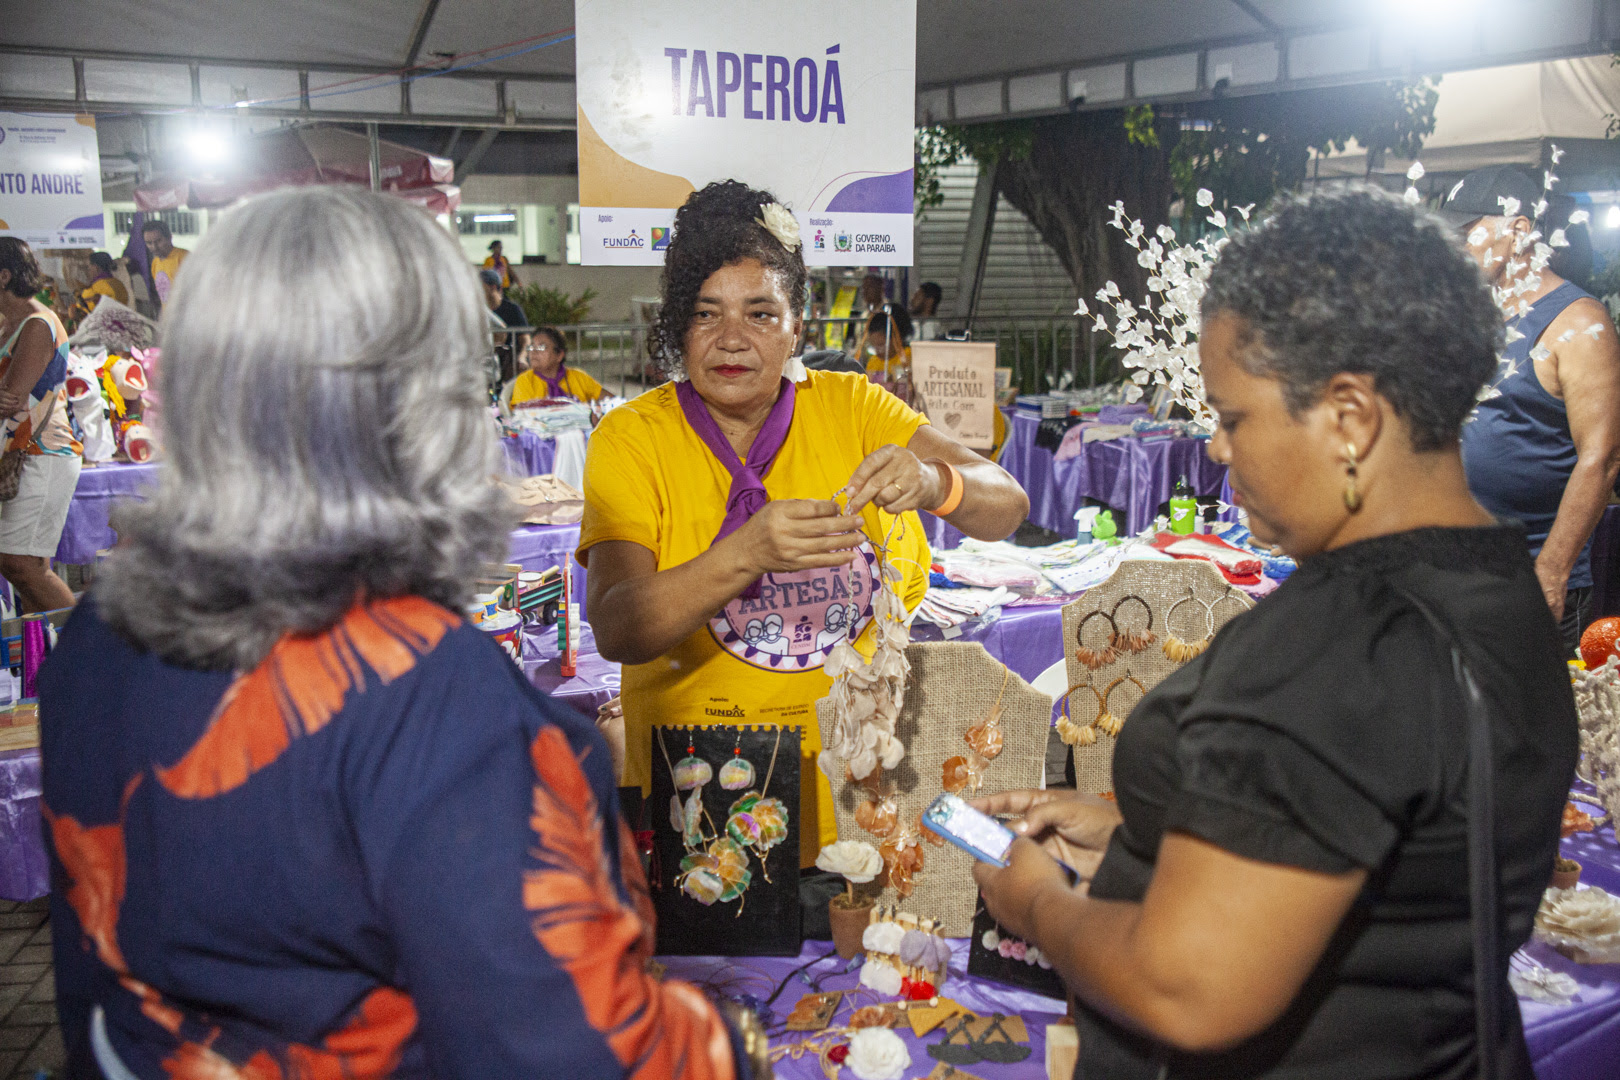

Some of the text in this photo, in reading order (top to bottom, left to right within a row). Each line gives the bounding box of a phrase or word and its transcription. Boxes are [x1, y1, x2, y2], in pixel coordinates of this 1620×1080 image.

[664, 43, 846, 125] TAPEROÁ
[809, 218, 834, 228] Realização:
[603, 237, 645, 248] FUNDAC
[855, 233, 891, 243] GOVERNO
[855, 243, 896, 253] DA PARAÍBA
[929, 366, 977, 380] Produto
[922, 381, 987, 398] ARTESANAL
[738, 567, 863, 615] ARTESÃS
[705, 707, 745, 717] FUNDAC
